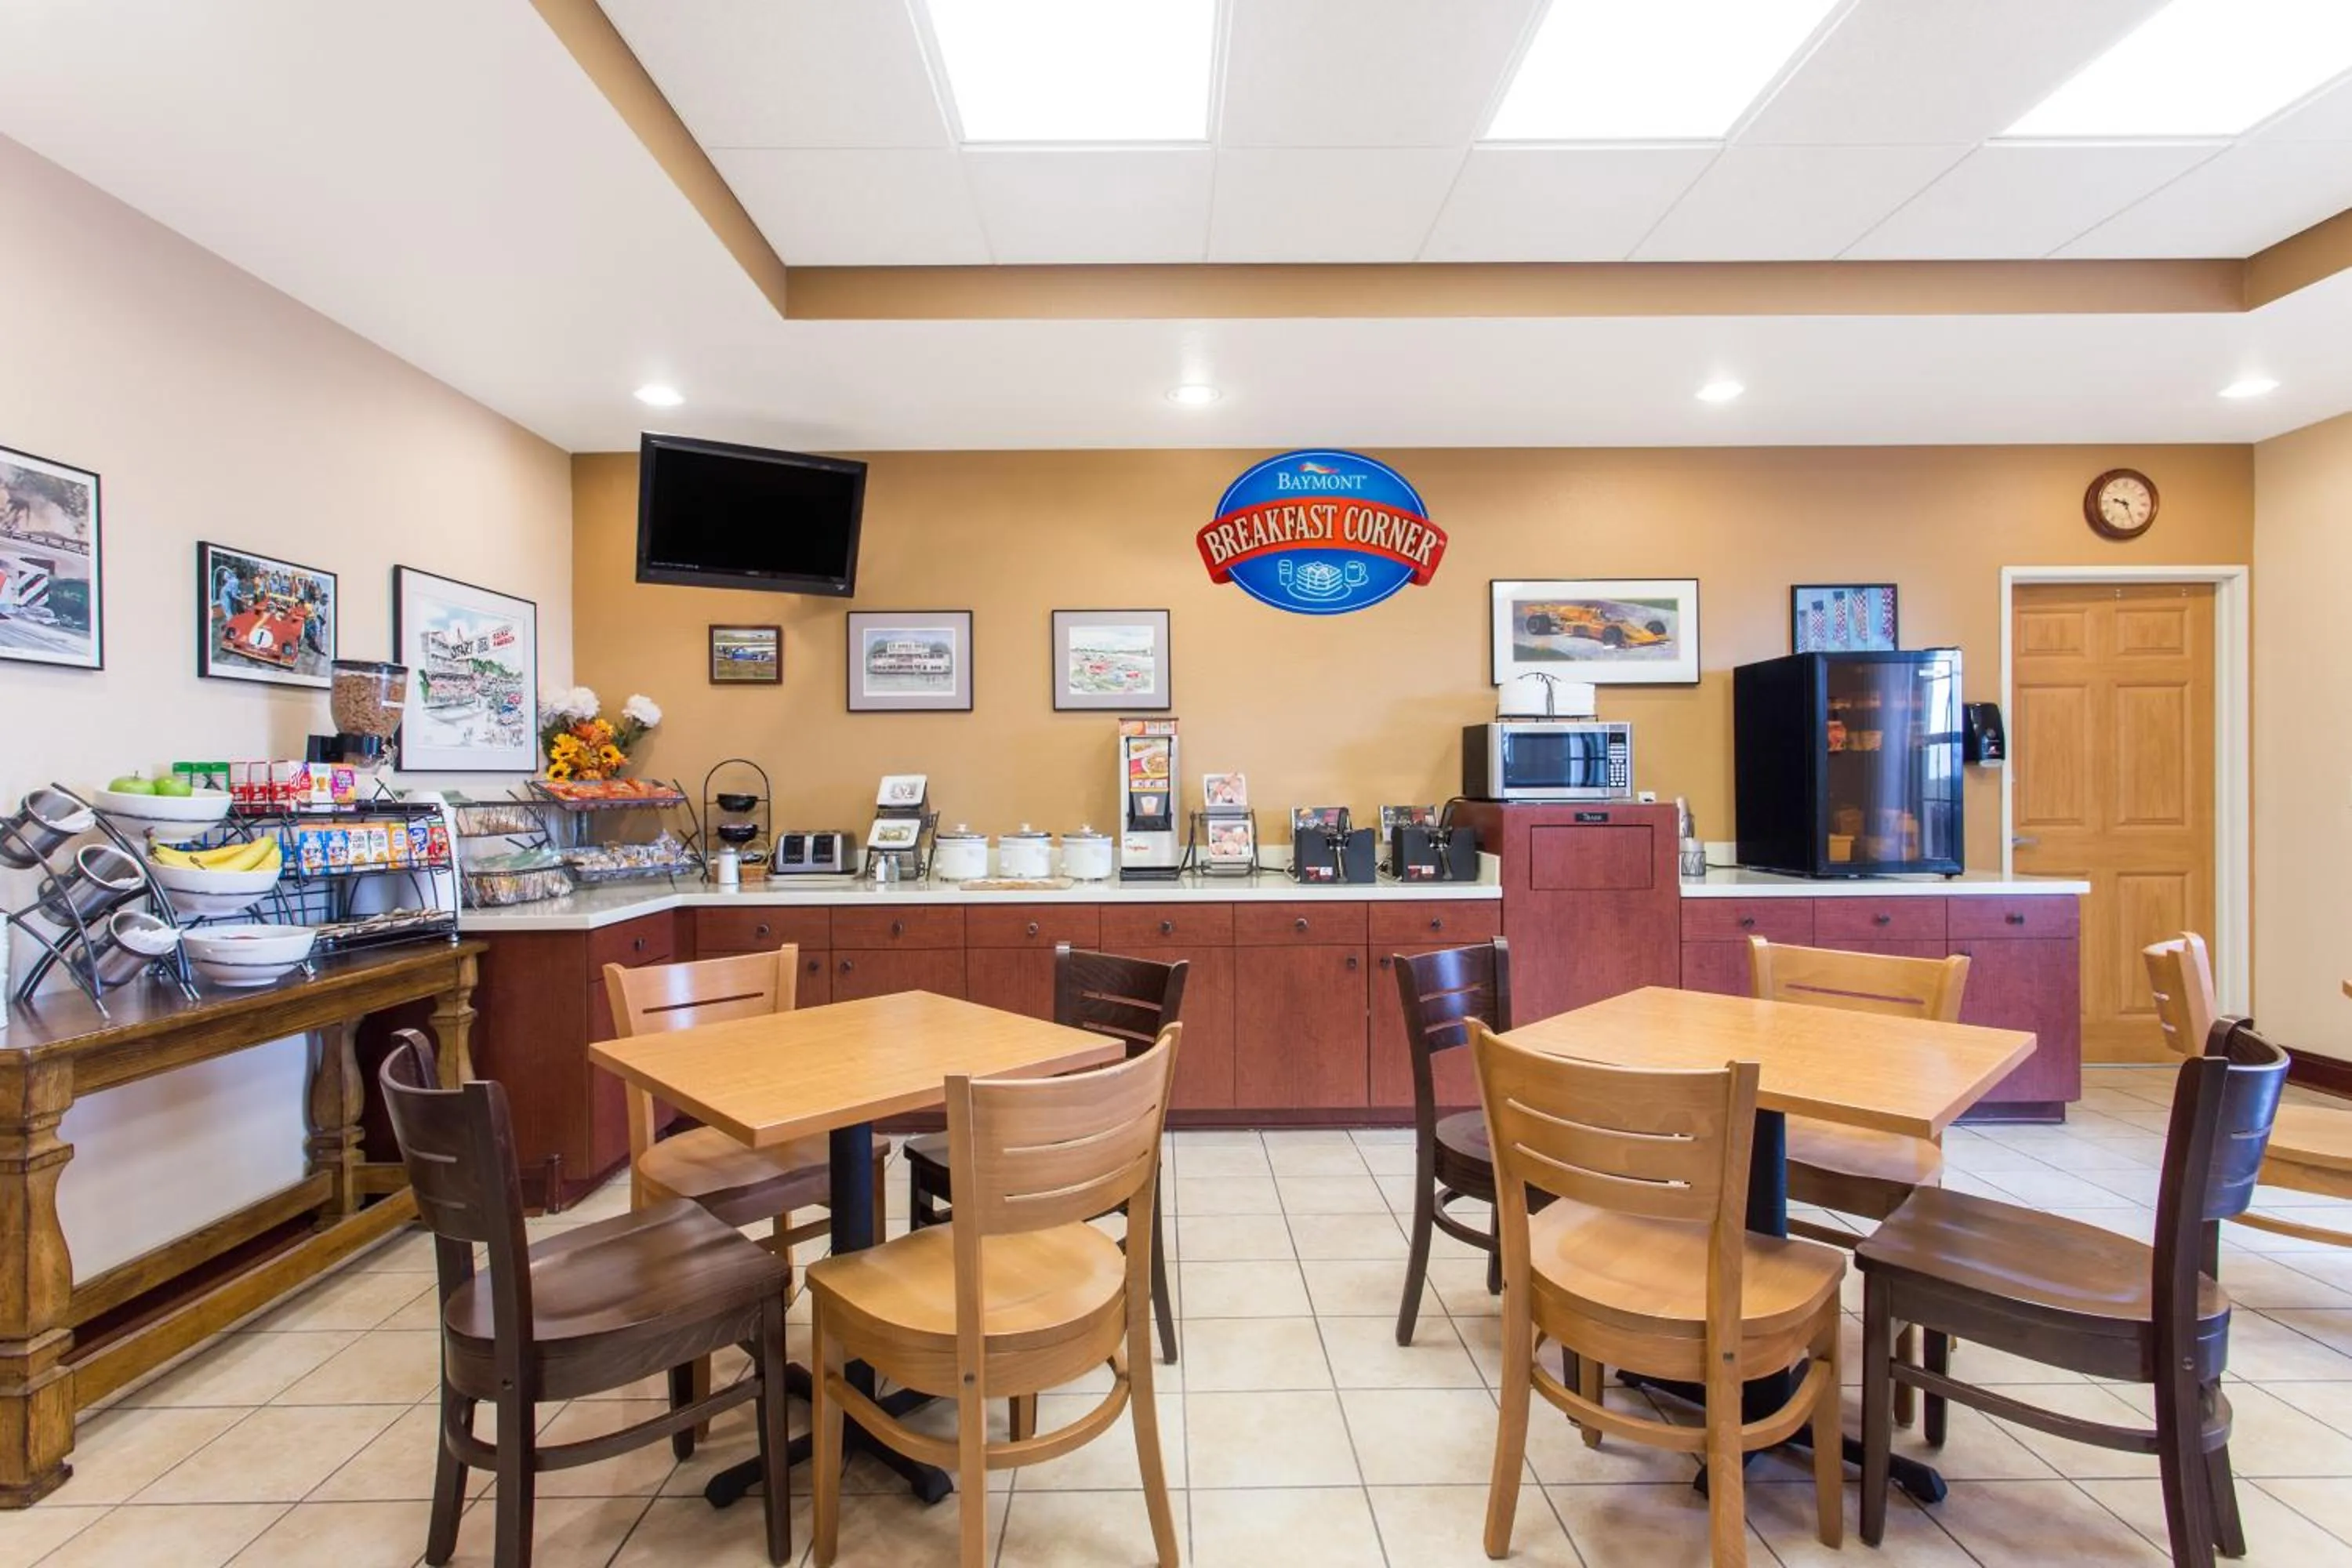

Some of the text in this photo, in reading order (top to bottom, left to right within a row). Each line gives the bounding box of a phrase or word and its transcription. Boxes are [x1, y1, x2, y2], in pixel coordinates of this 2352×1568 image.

[1278, 473, 1363, 490] BAYMONT
[1203, 504, 1438, 567] BREAKFAST CORNER
[256, 631, 264, 645] 1
[450, 641, 474, 659] START
